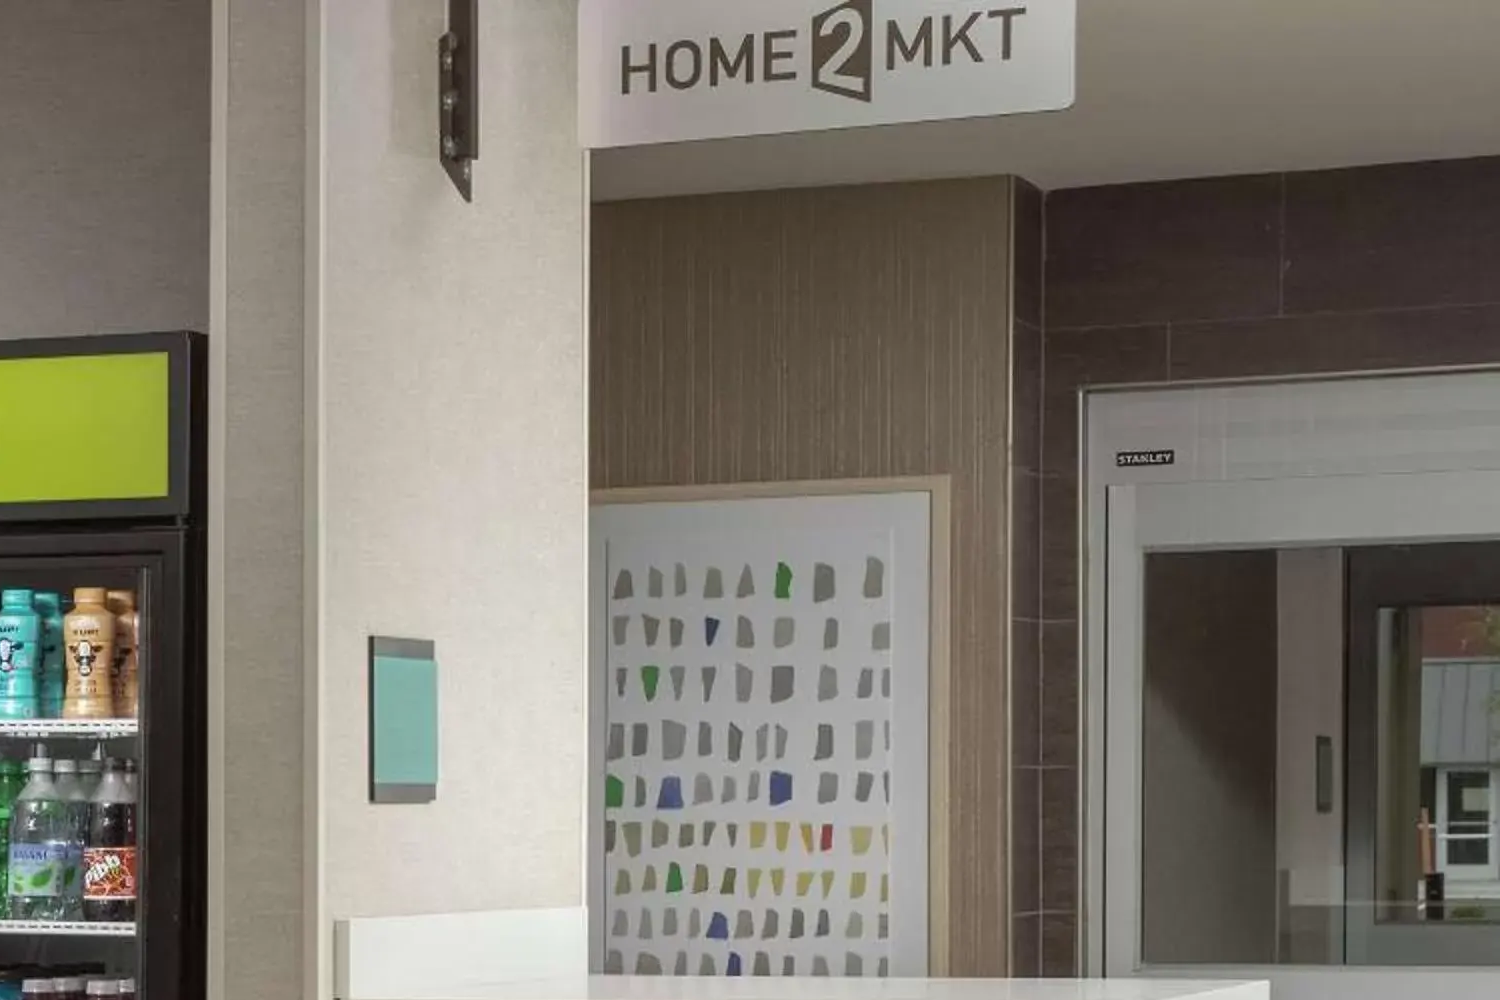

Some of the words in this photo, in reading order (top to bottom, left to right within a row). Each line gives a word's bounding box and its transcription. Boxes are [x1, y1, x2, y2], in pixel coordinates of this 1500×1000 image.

[619, 28, 798, 96] HOME
[818, 7, 867, 93] 2
[884, 6, 1027, 71] MKT
[1117, 452, 1173, 465] STANLEY
